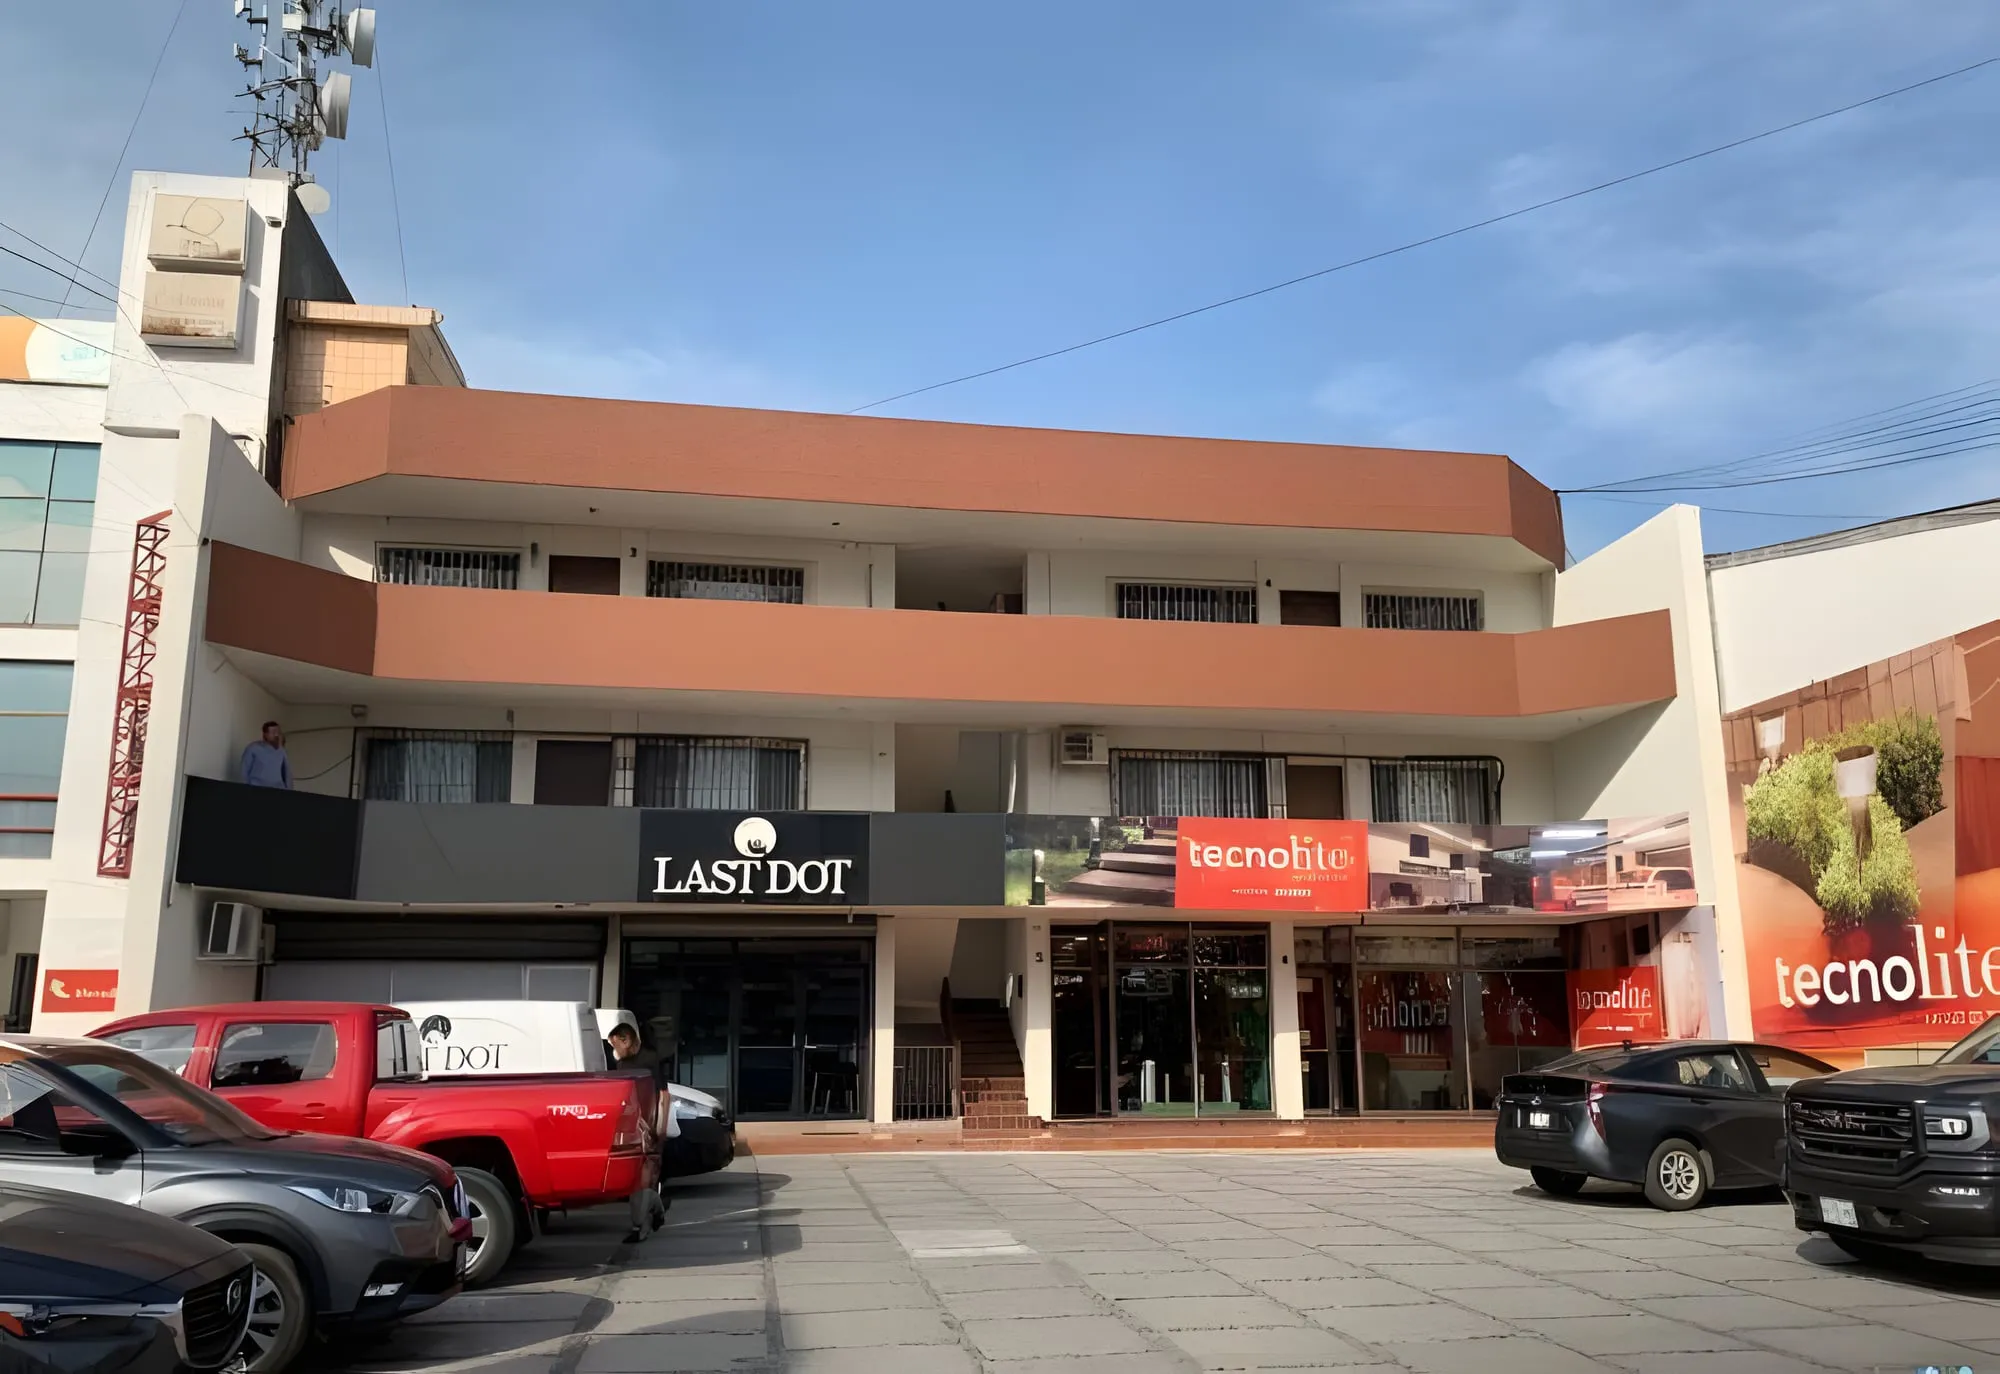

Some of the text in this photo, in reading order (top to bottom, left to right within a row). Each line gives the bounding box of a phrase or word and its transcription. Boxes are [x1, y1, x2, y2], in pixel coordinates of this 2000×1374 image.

[652, 856, 853, 895] LAST DOT
[1775, 923, 2000, 1009] tecnolite
[445, 1043, 508, 1071] DOT
